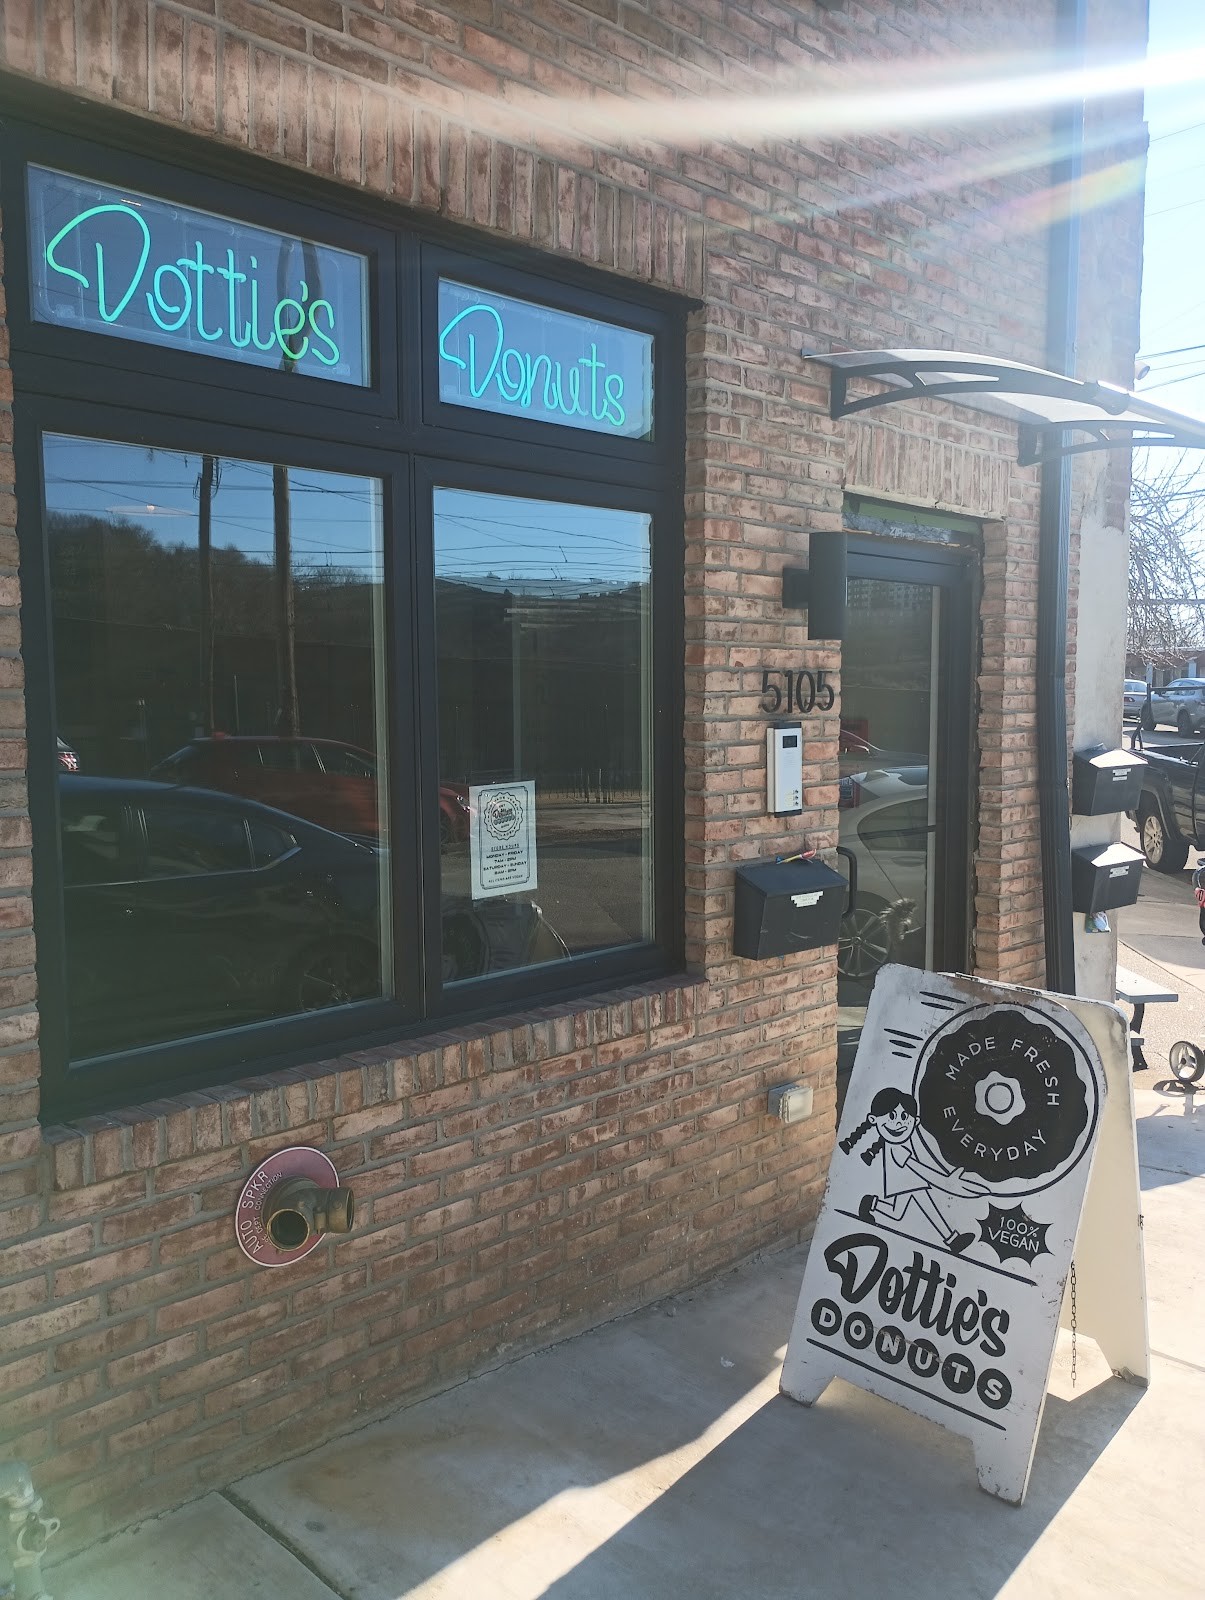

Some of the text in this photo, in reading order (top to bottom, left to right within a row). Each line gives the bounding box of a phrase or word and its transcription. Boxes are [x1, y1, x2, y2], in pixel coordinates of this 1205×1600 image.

[46, 204, 626, 427] Dottie's Donuts
[761, 669, 835, 714] 5105
[945, 1036, 1060, 1107] MADE FRESH
[943, 1106, 1047, 1162] EVERYDAY
[240, 1171, 268, 1254] AUTO SPKR
[253, 1216, 264, 1234] DEPT
[988, 1226, 1040, 1253] VEGAN
[1000, 1216, 1040, 1238] 100%
[823, 1232, 1010, 1358] Dottie's
[816, 1303, 1005, 1403] DONUTS
